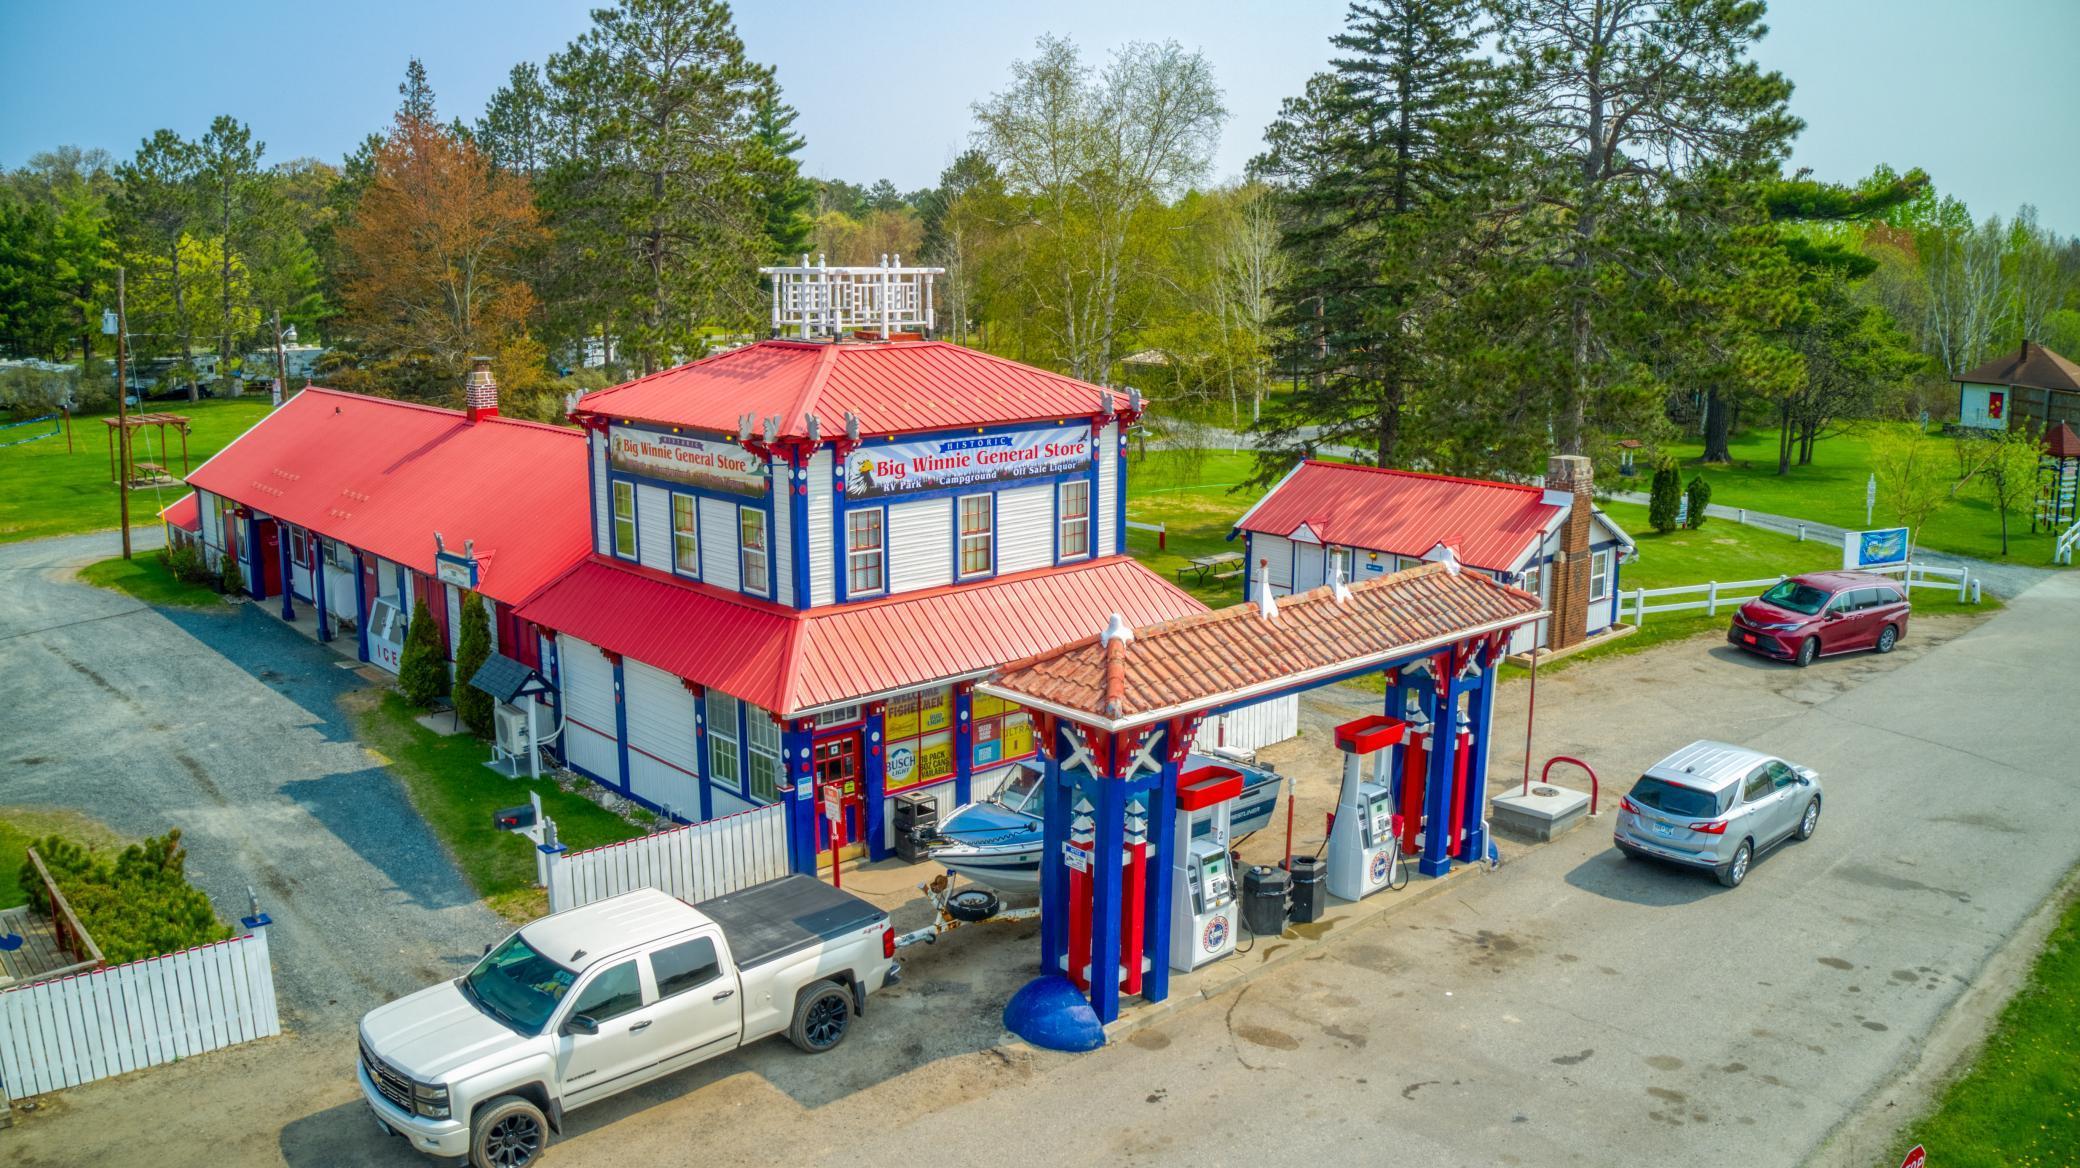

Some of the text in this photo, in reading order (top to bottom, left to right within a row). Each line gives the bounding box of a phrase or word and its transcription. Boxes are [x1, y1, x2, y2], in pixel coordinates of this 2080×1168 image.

[947, 438, 1006, 450] HISTORIC
[623, 439, 746, 472] Big Winnie General Store
[877, 443, 1085, 480] Big Winnie General Store
[883, 462, 1077, 492] RV Park Campground Off Sale Liquor
[377, 643, 398, 666] ICE
[888, 695, 944, 719] FISHEMEN
[887, 755, 916, 772] BUSCH
[929, 751, 946, 761] PACK
[891, 767, 910, 777] LIGHT
[1218, 831, 1224, 840] 2
